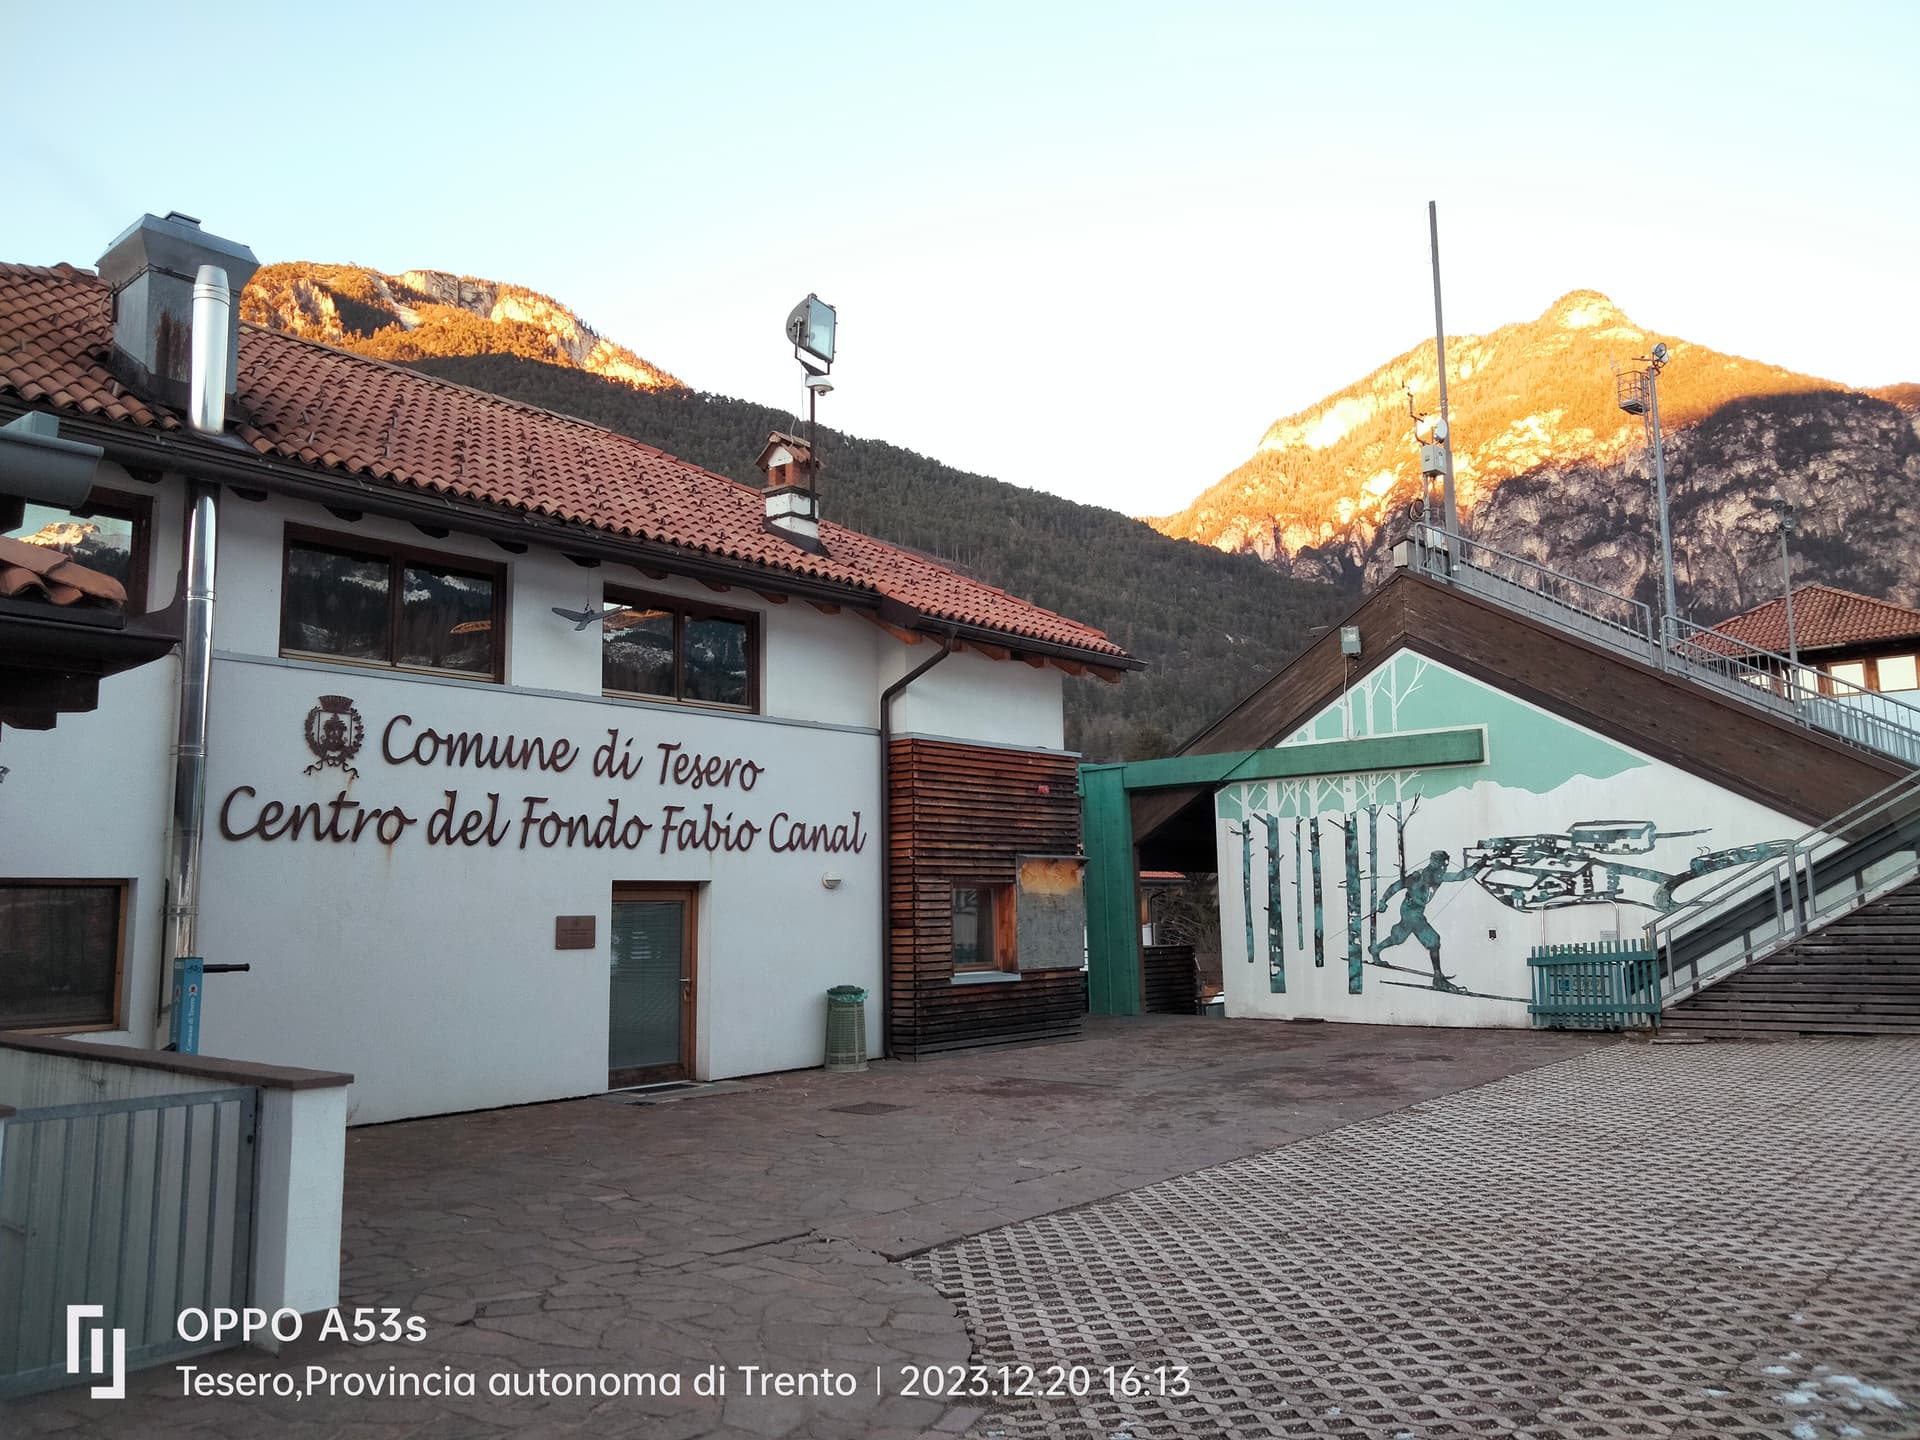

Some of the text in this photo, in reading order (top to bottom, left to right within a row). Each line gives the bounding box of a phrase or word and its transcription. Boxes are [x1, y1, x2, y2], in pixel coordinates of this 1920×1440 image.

[381, 714, 765, 792] Comune di Tesero
[218, 785, 868, 855] Centro del Fondo Fabio Canal
